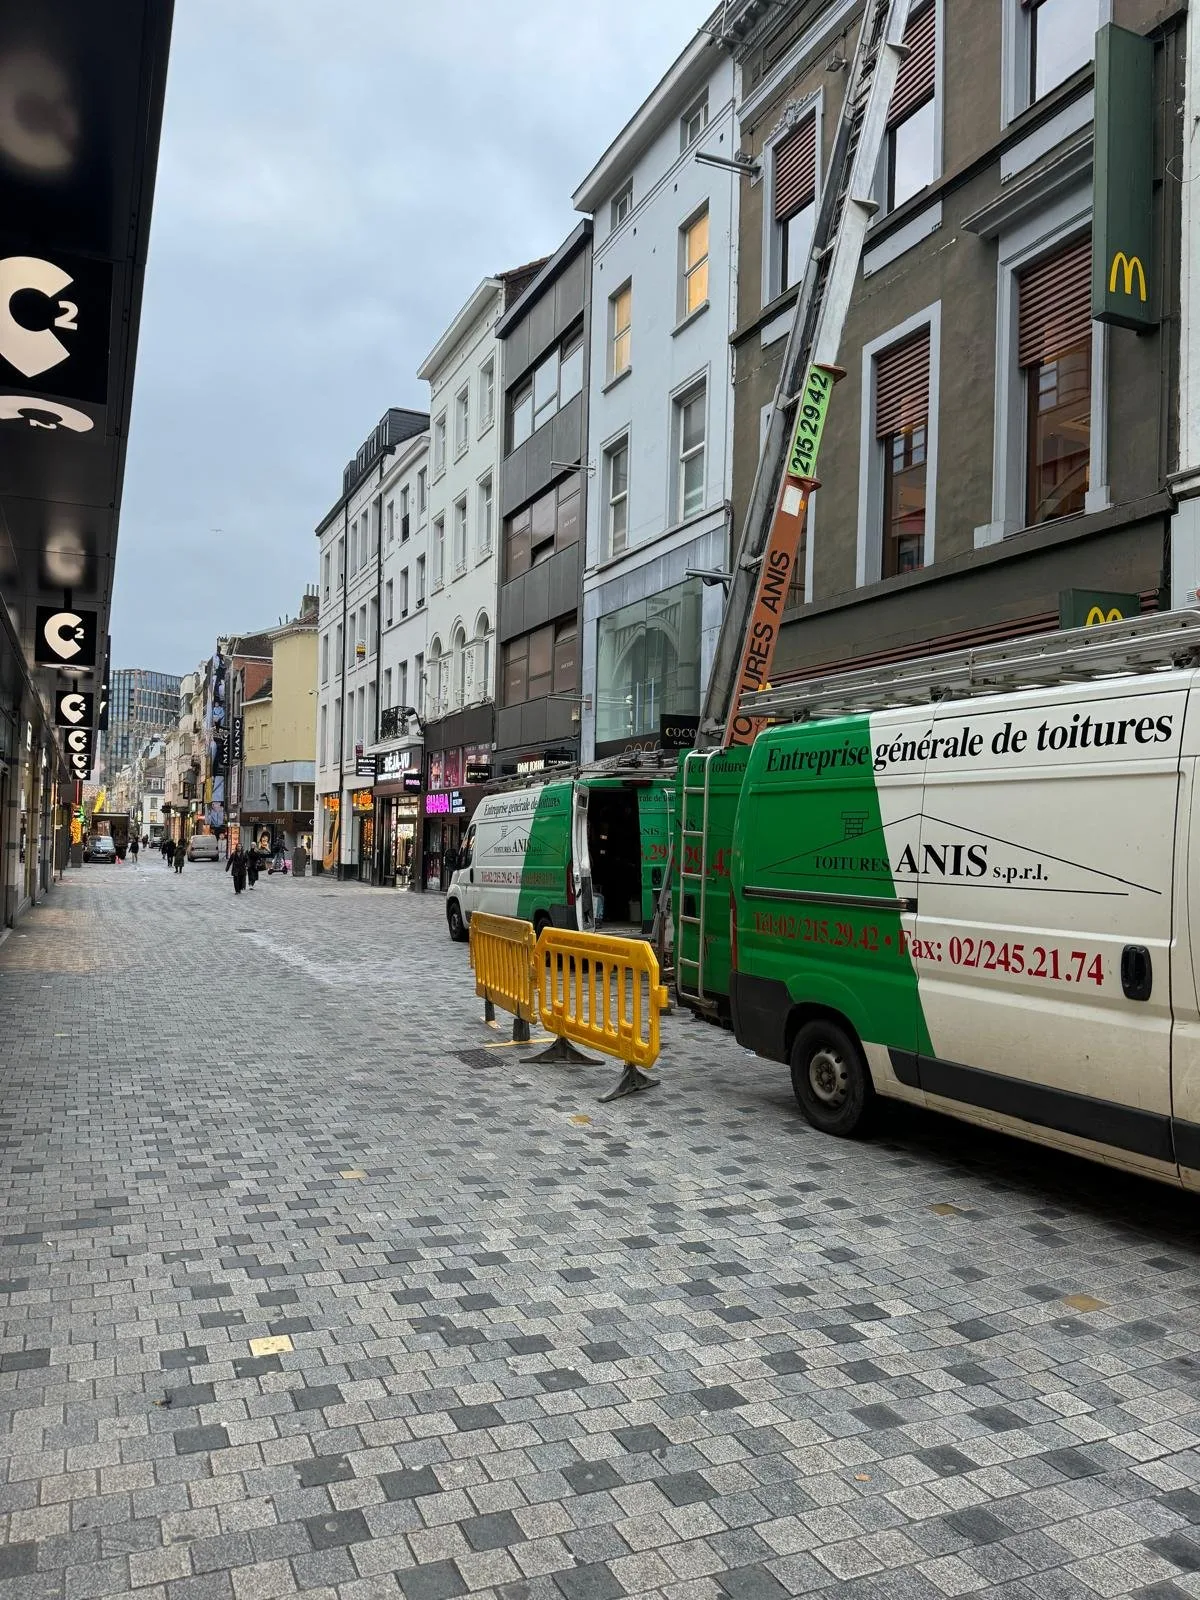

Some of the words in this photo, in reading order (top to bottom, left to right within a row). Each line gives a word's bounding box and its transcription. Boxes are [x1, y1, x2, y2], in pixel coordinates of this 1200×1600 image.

[791, 436, 815, 475] 215
[728, 621, 775, 748] TOURES
[760, 550, 790, 615] ANIS
[665, 727, 697, 739] COCO
[767, 740, 869, 775] Entreprise
[873, 726, 984, 772] générale
[991, 722, 1028, 754] de
[1036, 713, 1174, 752] toitures
[483, 800, 509, 818] Entreprise
[512, 838, 532, 853] ANIS
[813, 855, 890, 873] TOITURES
[894, 843, 988, 878] ANIS
[992, 863, 1049, 884] s.p.r.l.
[897, 930, 943, 962] Fax:
[948, 935, 1105, 986] 02/245.21.74
